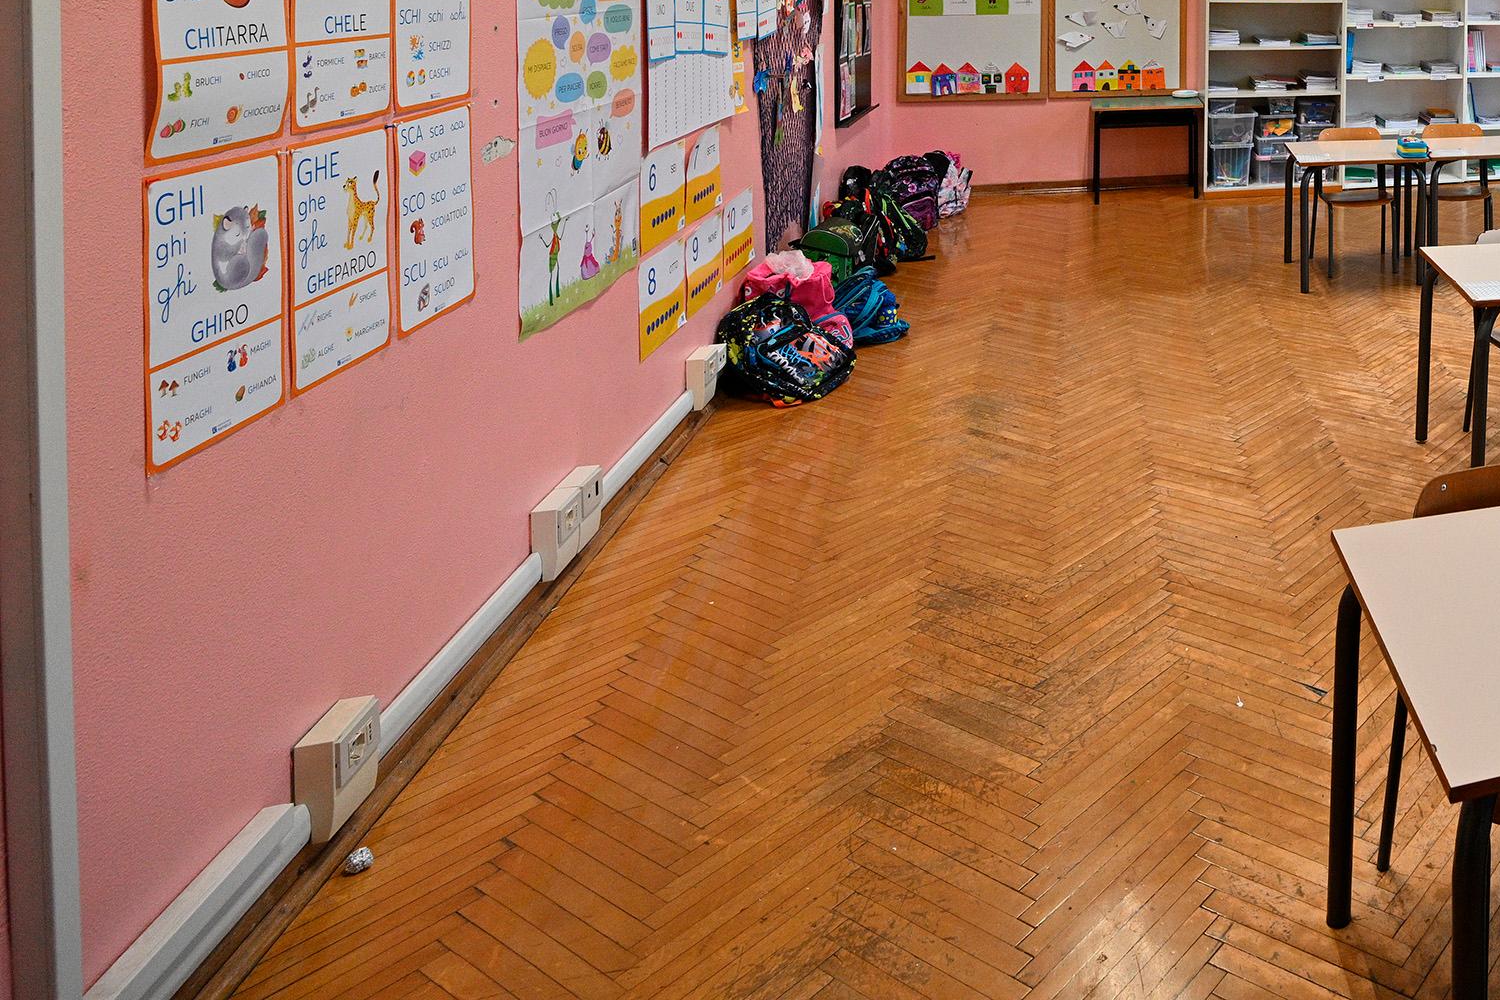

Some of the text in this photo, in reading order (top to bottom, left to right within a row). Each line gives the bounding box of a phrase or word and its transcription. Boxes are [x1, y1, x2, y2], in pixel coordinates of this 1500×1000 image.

[324, 13, 367, 34] CHELE
[399, 8, 421, 25] SCHI
[428, 9, 444, 23] schi
[185, 23, 270, 50] CHITARRA
[316, 56, 345, 68] FORMICHE
[368, 51, 386, 61] BARCHE
[195, 75, 222, 88] BRUCHI
[246, 68, 271, 80] CHICCO
[428, 67, 451, 80] CASCHI
[319, 92, 335, 103] OCHE
[368, 83, 386, 94] ZUCCHE
[243, 104, 281, 119] CHIOCCIOLA
[190, 117, 210, 129] FICHI
[400, 124, 424, 147] SCA
[429, 124, 445, 139] sca
[430, 146, 456, 163] SCATOLA
[693, 144, 700, 170] 7
[297, 151, 340, 187] GHE
[648, 163, 657, 192] 6
[155, 184, 204, 226] GHI
[298, 194, 326, 223] ghe
[402, 191, 425, 217] SCO
[431, 189, 447, 205] sco
[431, 205, 468, 230] SCOIATTOLO
[727, 207, 736, 232] 10
[156, 231, 187, 269] ghi
[298, 219, 328, 270] ghe
[692, 236, 699, 262] 9
[307, 250, 377, 295] GHEPARDO
[403, 259, 427, 287] SCU
[433, 255, 449, 272] scu
[647, 267, 657, 296] 8
[157, 263, 198, 324] ghi
[434, 276, 456, 297] SCUDO
[190, 303, 249, 343] GHIRO
[249, 339, 272, 356] MAGHI
[317, 343, 335, 359] ALGHE
[183, 365, 212, 385] FUNGHI
[247, 374, 277, 395] GHIANDA
[184, 405, 212, 427] DRAGHI
